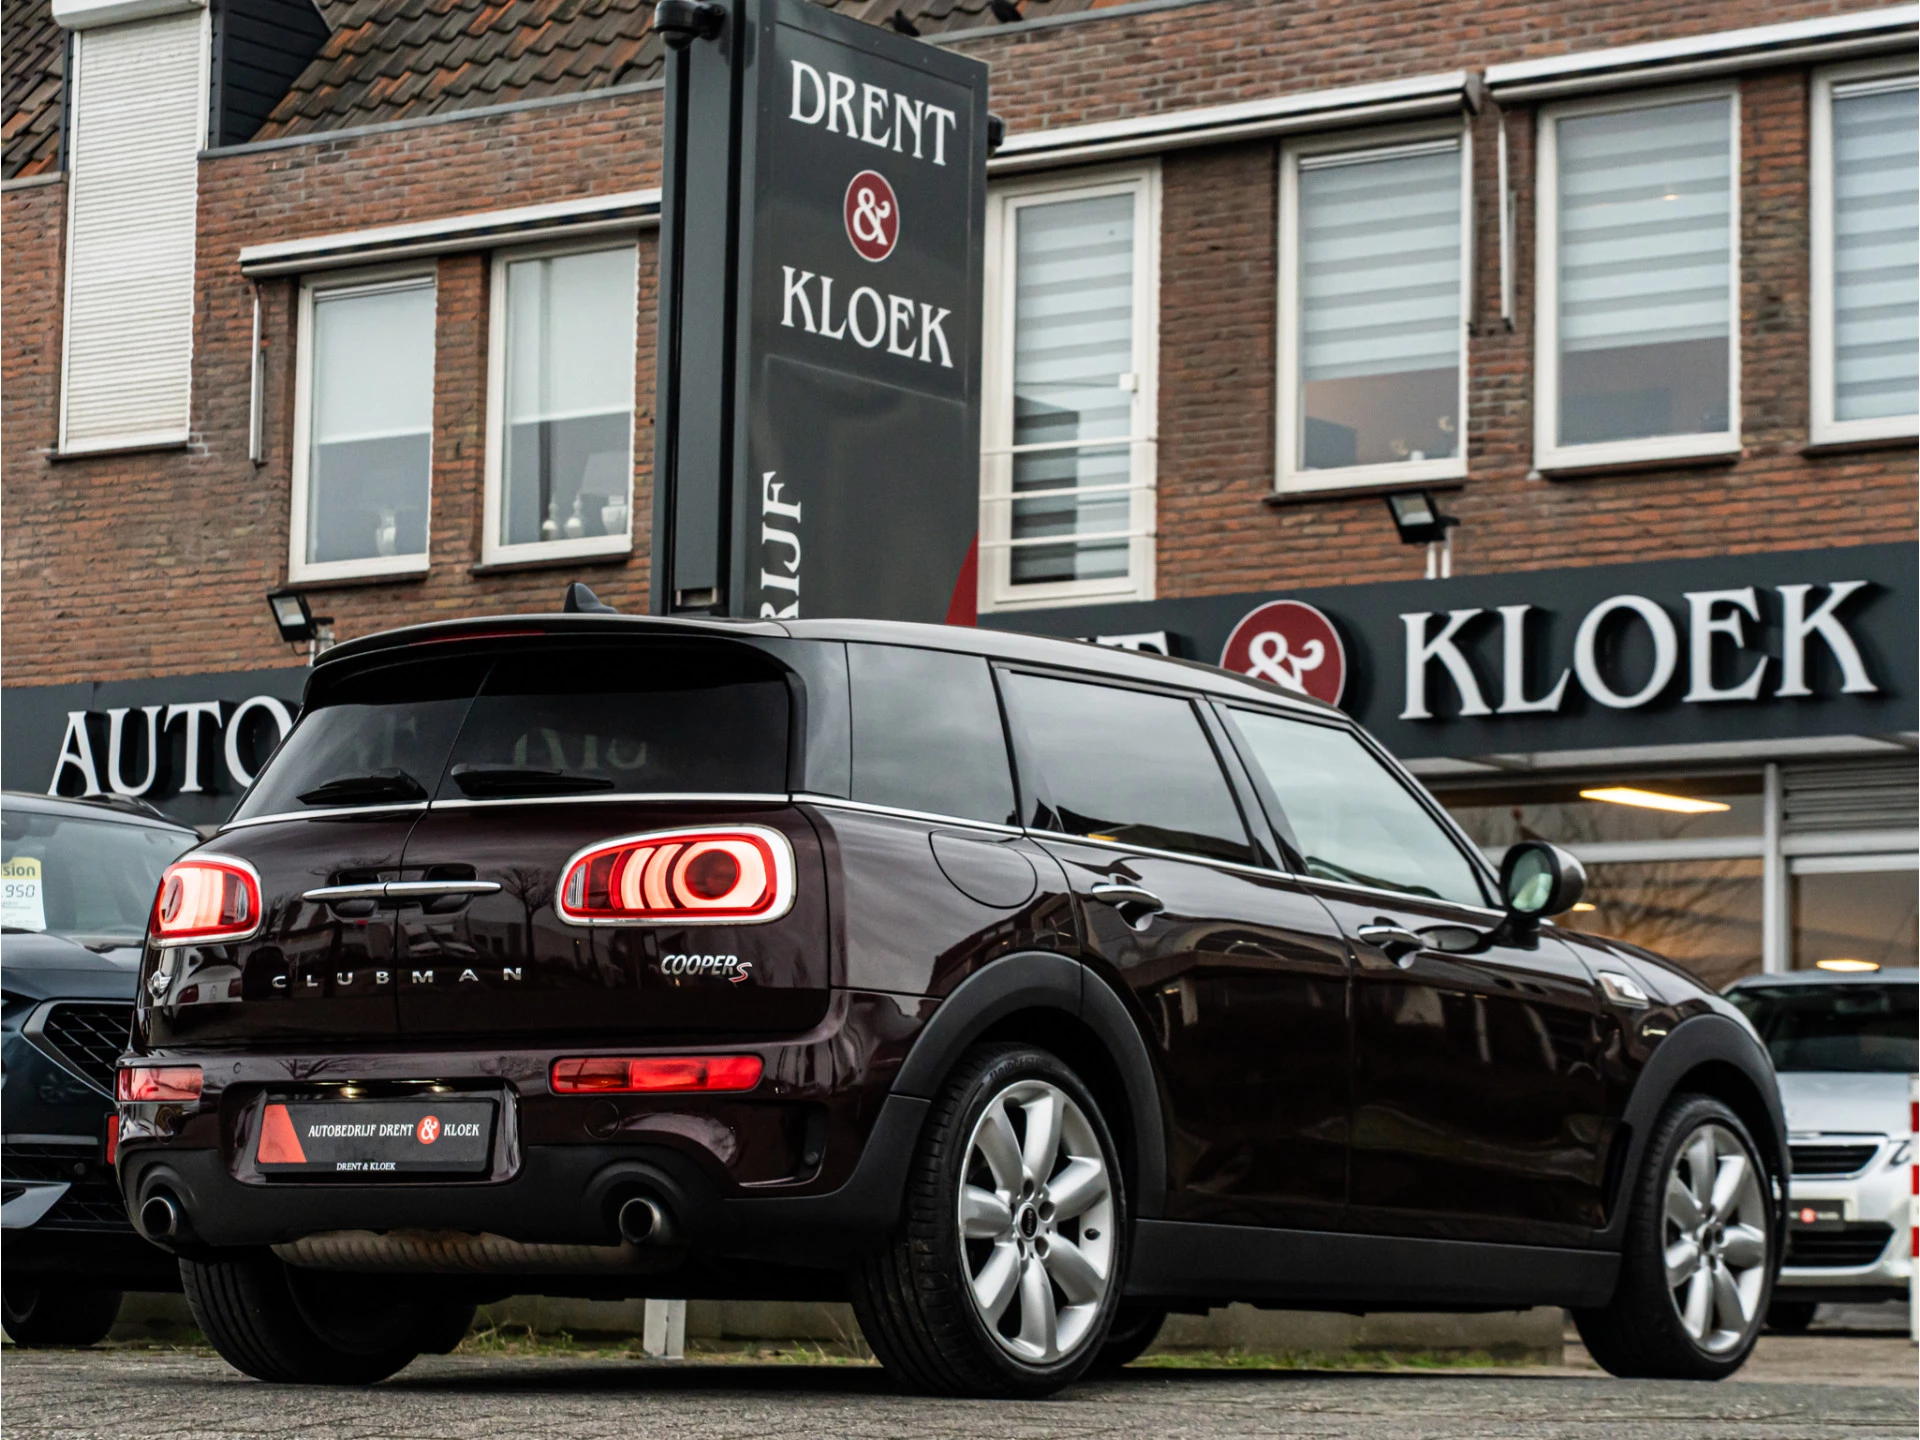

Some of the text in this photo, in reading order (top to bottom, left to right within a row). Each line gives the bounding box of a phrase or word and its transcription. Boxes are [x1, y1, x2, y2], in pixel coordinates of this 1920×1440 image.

[788, 60, 957, 166] DRENT
[852, 187, 891, 246] &
[780, 265, 954, 369] KLOEK
[1245, 580, 1879, 721] & KLOEK
[47, 695, 293, 798] AUTO
[1, 863, 36, 877] sion
[271, 967, 522, 989] CLUBMAN
[660, 954, 753, 983] COOPER S
[308, 1118, 480, 1141] AUTOBEDRIJF DRENT & KLOEK
[336, 1162, 362, 1171] DRENT
[370, 1162, 396, 1171] KLOEK
